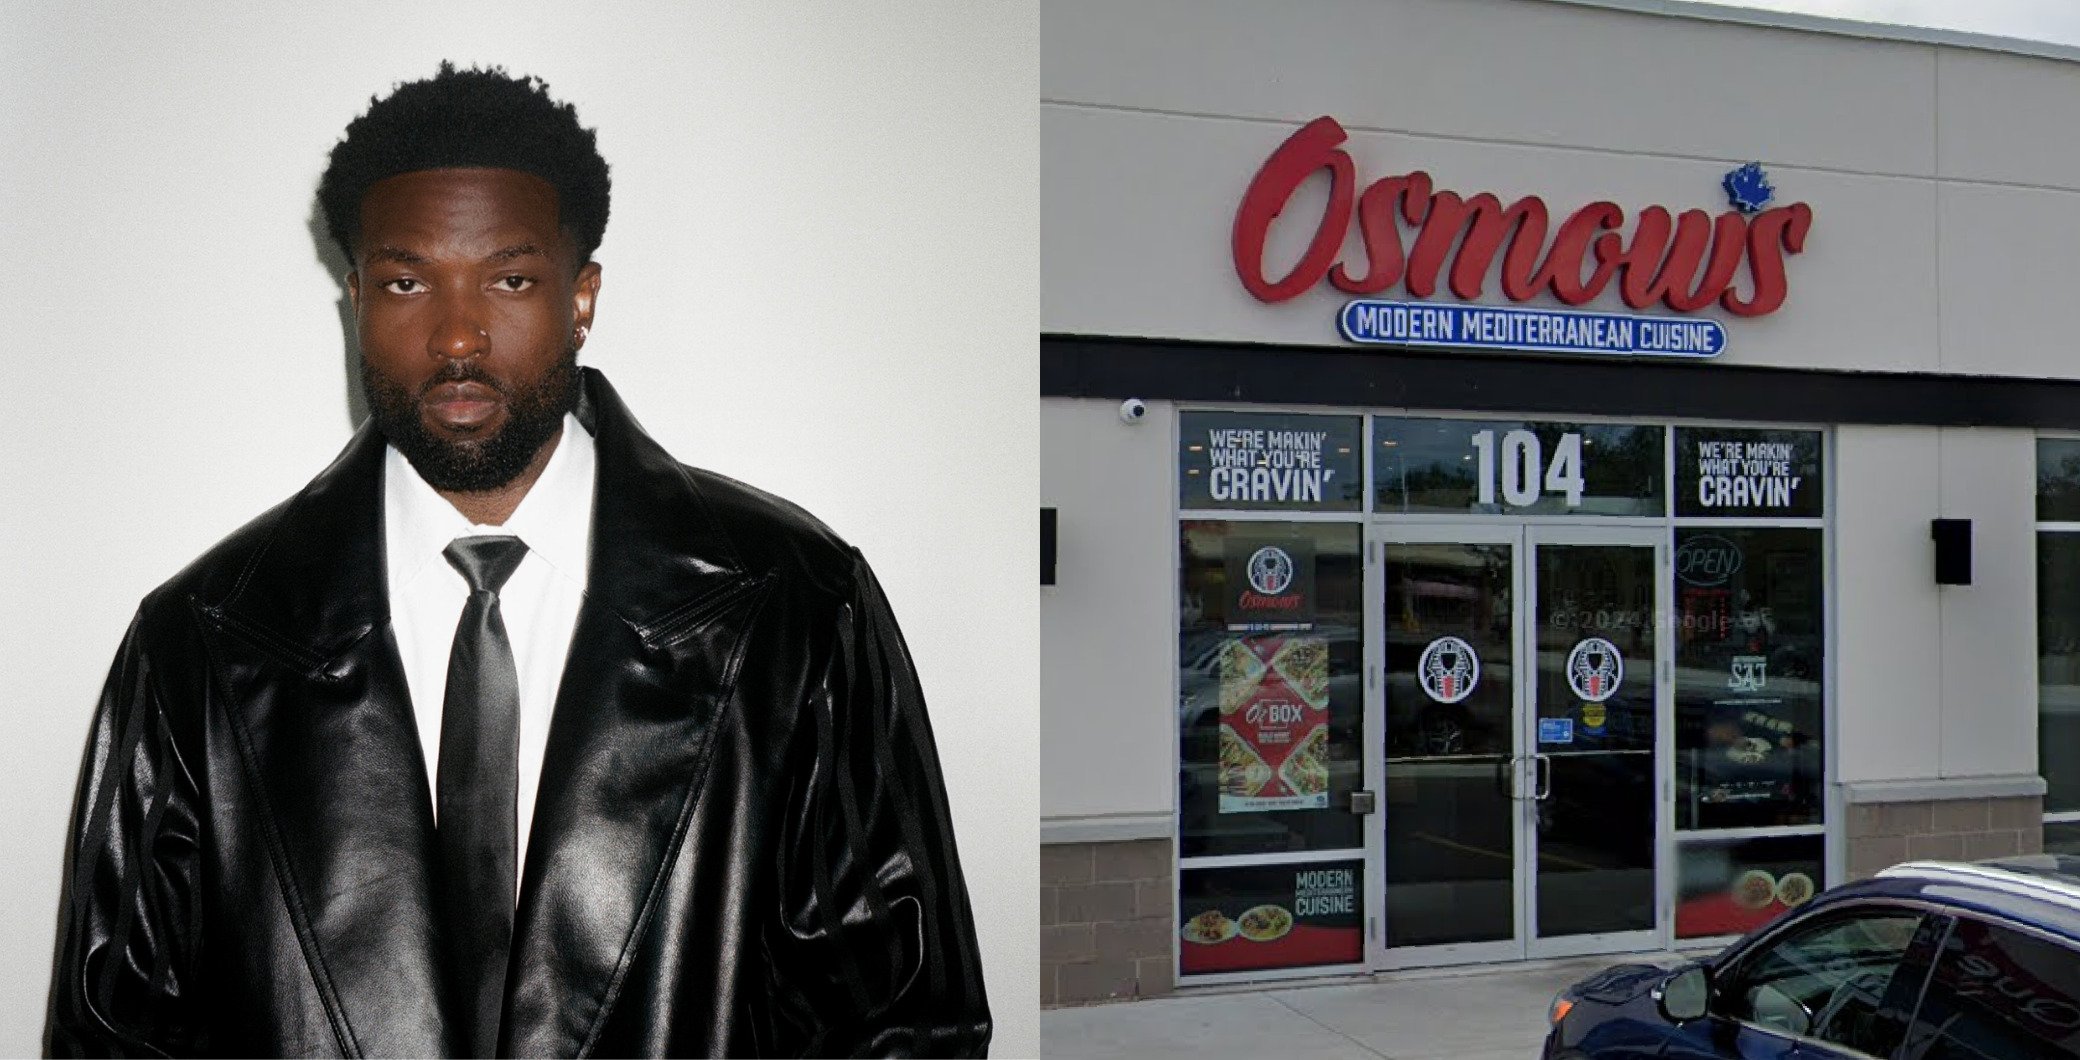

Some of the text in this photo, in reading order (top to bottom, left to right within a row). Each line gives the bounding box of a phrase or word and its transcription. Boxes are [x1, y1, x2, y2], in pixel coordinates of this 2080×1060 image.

[1356, 304, 1715, 353] MODERN MEDITERRANEAN CUISINE
[1210, 429, 1327, 450] WE'RE MAKIN'
[1698, 441, 1793, 459] WE'RE MAKIN'
[1210, 448, 1321, 469] WHAT YOU'RE
[1472, 429, 1584, 507] 104
[1699, 458, 1789, 476] WHAT YOU'RE
[1210, 466, 1335, 502] CRAVIN'
[1699, 475, 1801, 507] CRAVIN'
[1677, 548, 1735, 574] OPEN
[1268, 704, 1303, 723] BOX
[1295, 869, 1355, 888] MODERN
[1295, 895, 1355, 916] CUISINE
